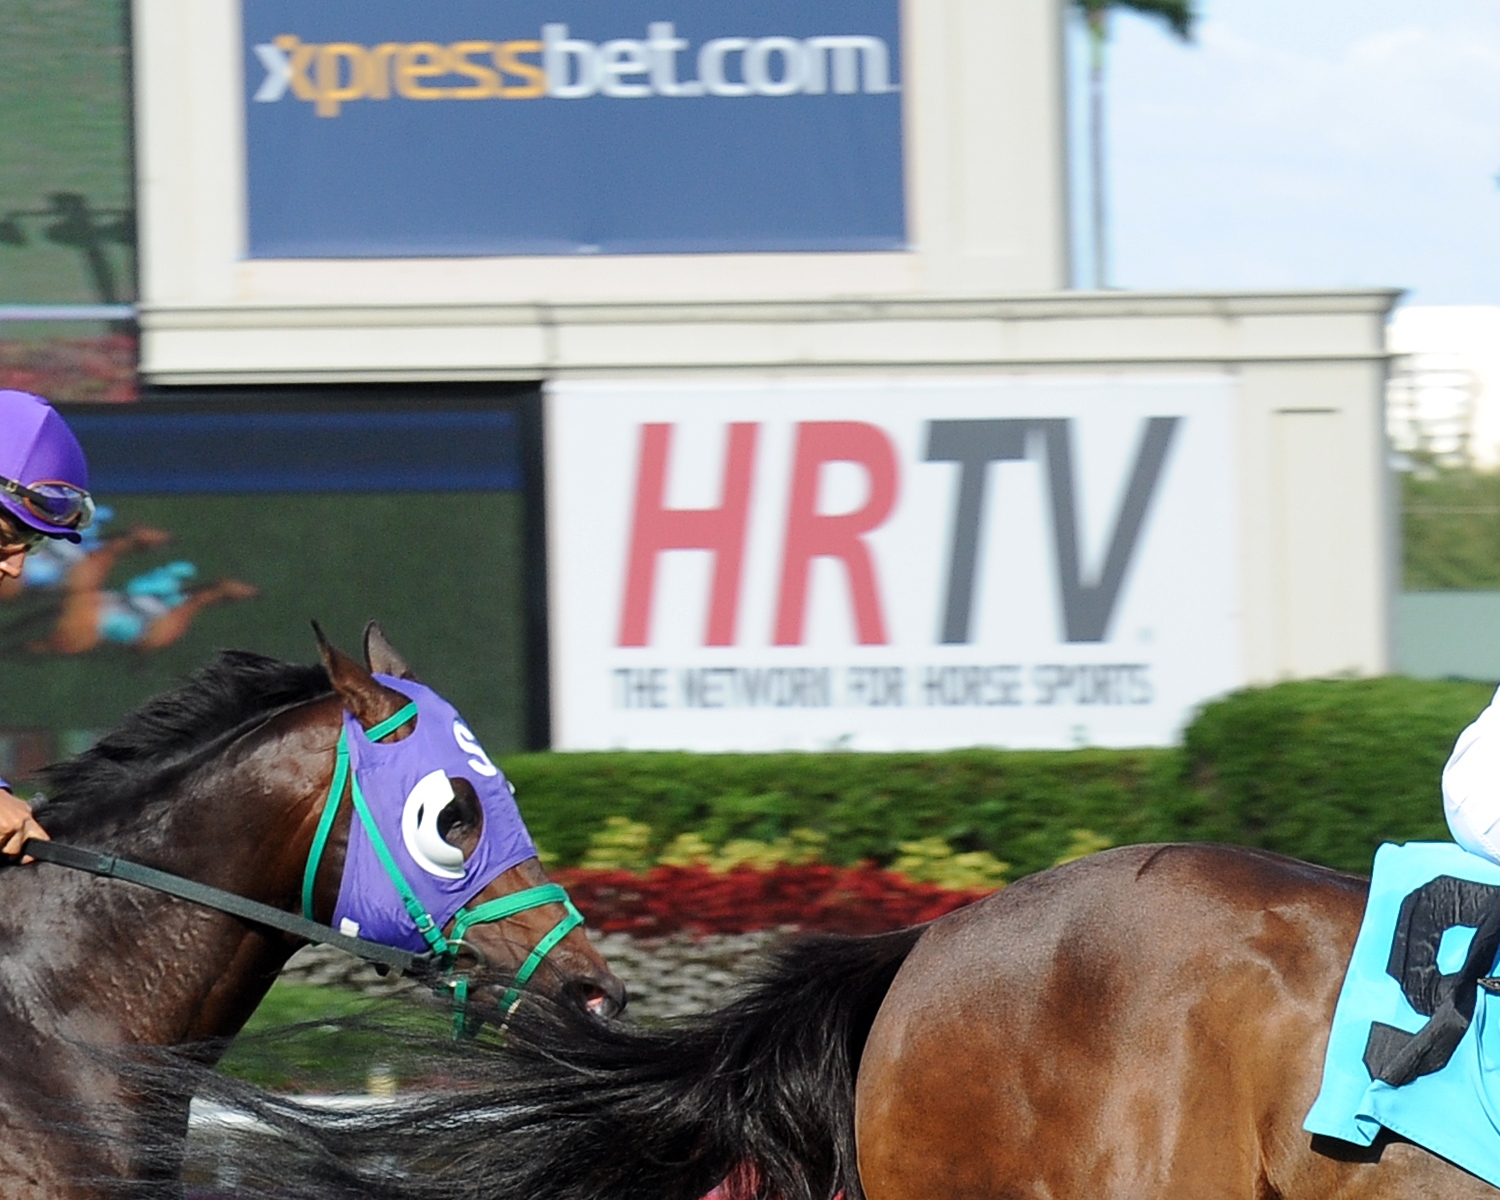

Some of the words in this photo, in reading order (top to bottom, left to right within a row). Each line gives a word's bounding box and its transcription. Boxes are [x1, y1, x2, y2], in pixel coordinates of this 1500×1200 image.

[252, 22, 890, 117] xpressbet.com
[614, 416, 1187, 647] HRTV
[612, 667, 667, 708] THE
[681, 666, 832, 708] NETWORK
[848, 666, 906, 707] FOR
[921, 664, 1024, 706] HORSE
[1032, 663, 1154, 705] SPORTS
